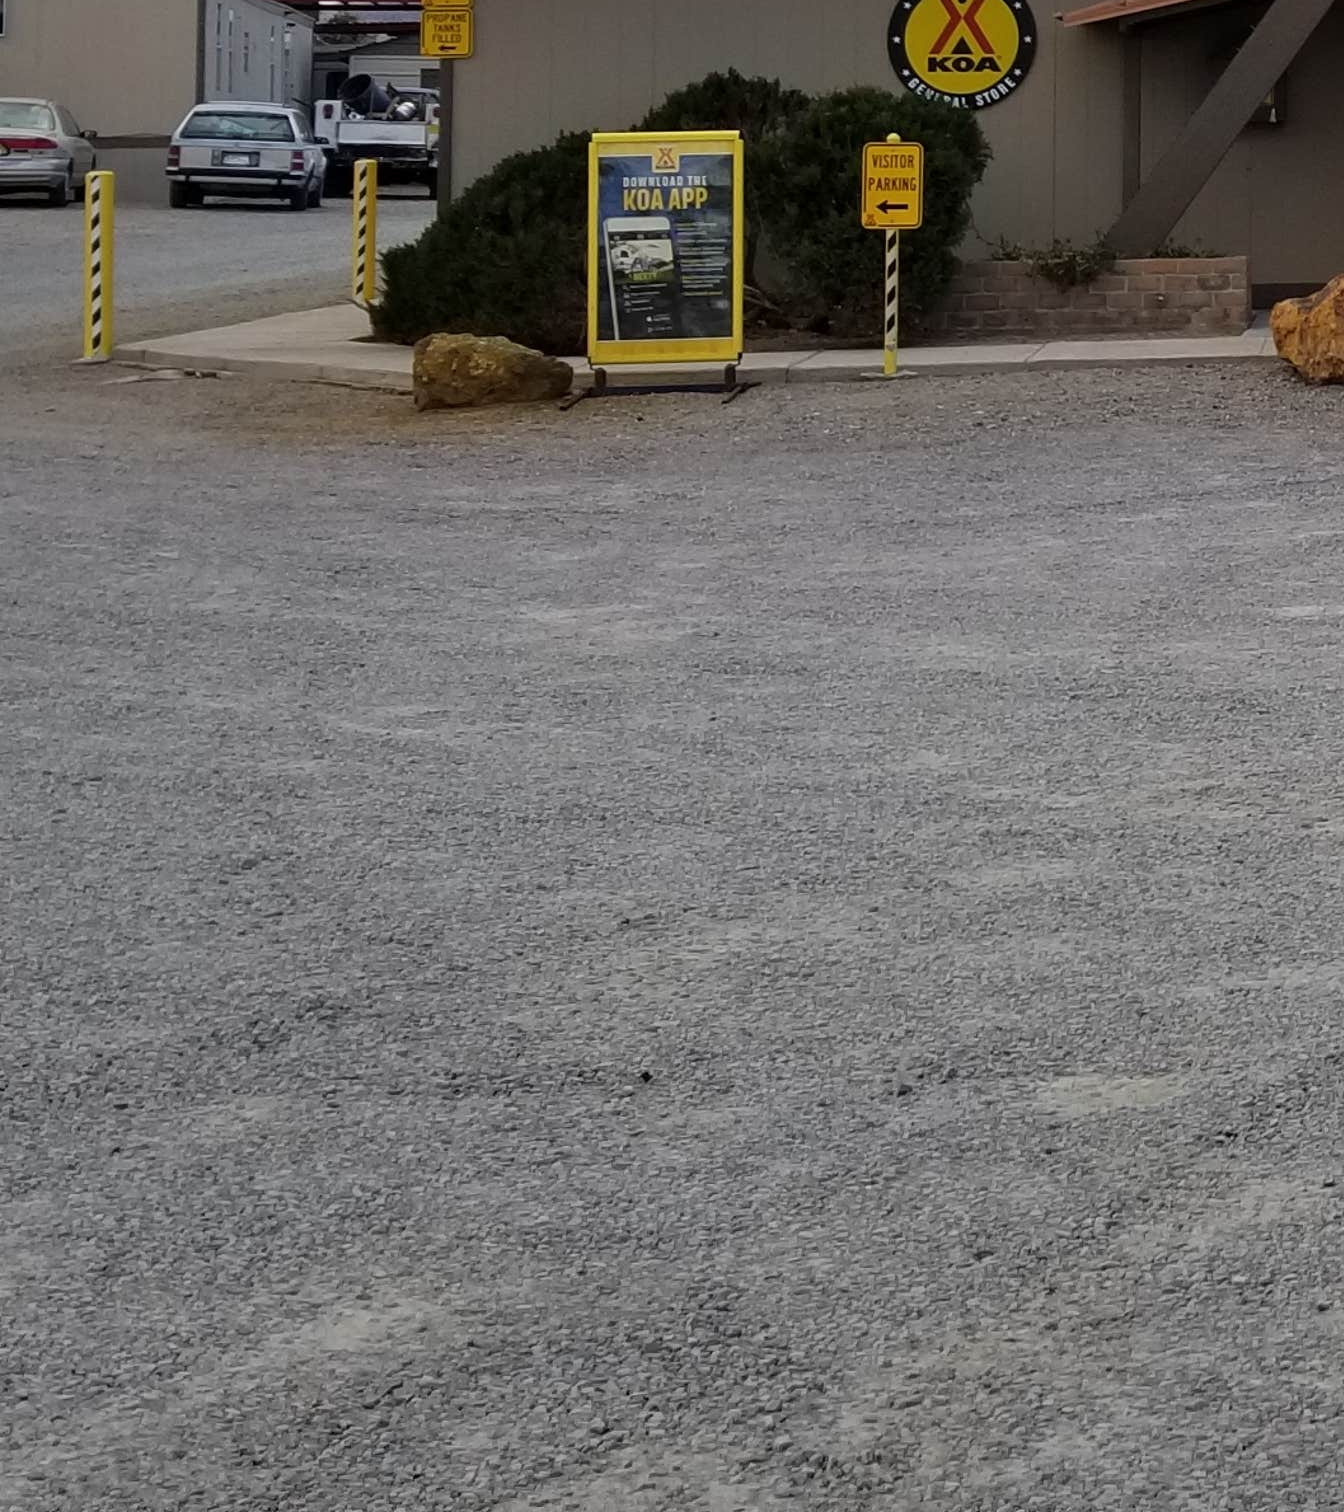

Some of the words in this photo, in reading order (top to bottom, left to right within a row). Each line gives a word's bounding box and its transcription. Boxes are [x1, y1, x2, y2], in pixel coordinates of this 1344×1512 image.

[433, 23, 461, 32] TANKS
[927, 56, 1002, 73] KOA
[975, 77, 1017, 106] STORE
[872, 154, 914, 169] VISITOR
[623, 176, 684, 187] DOWNLOAD
[687, 175, 707, 186] THE
[867, 176, 917, 192] PARKING
[623, 189, 664, 211] KOA
[668, 188, 708, 210] APP
